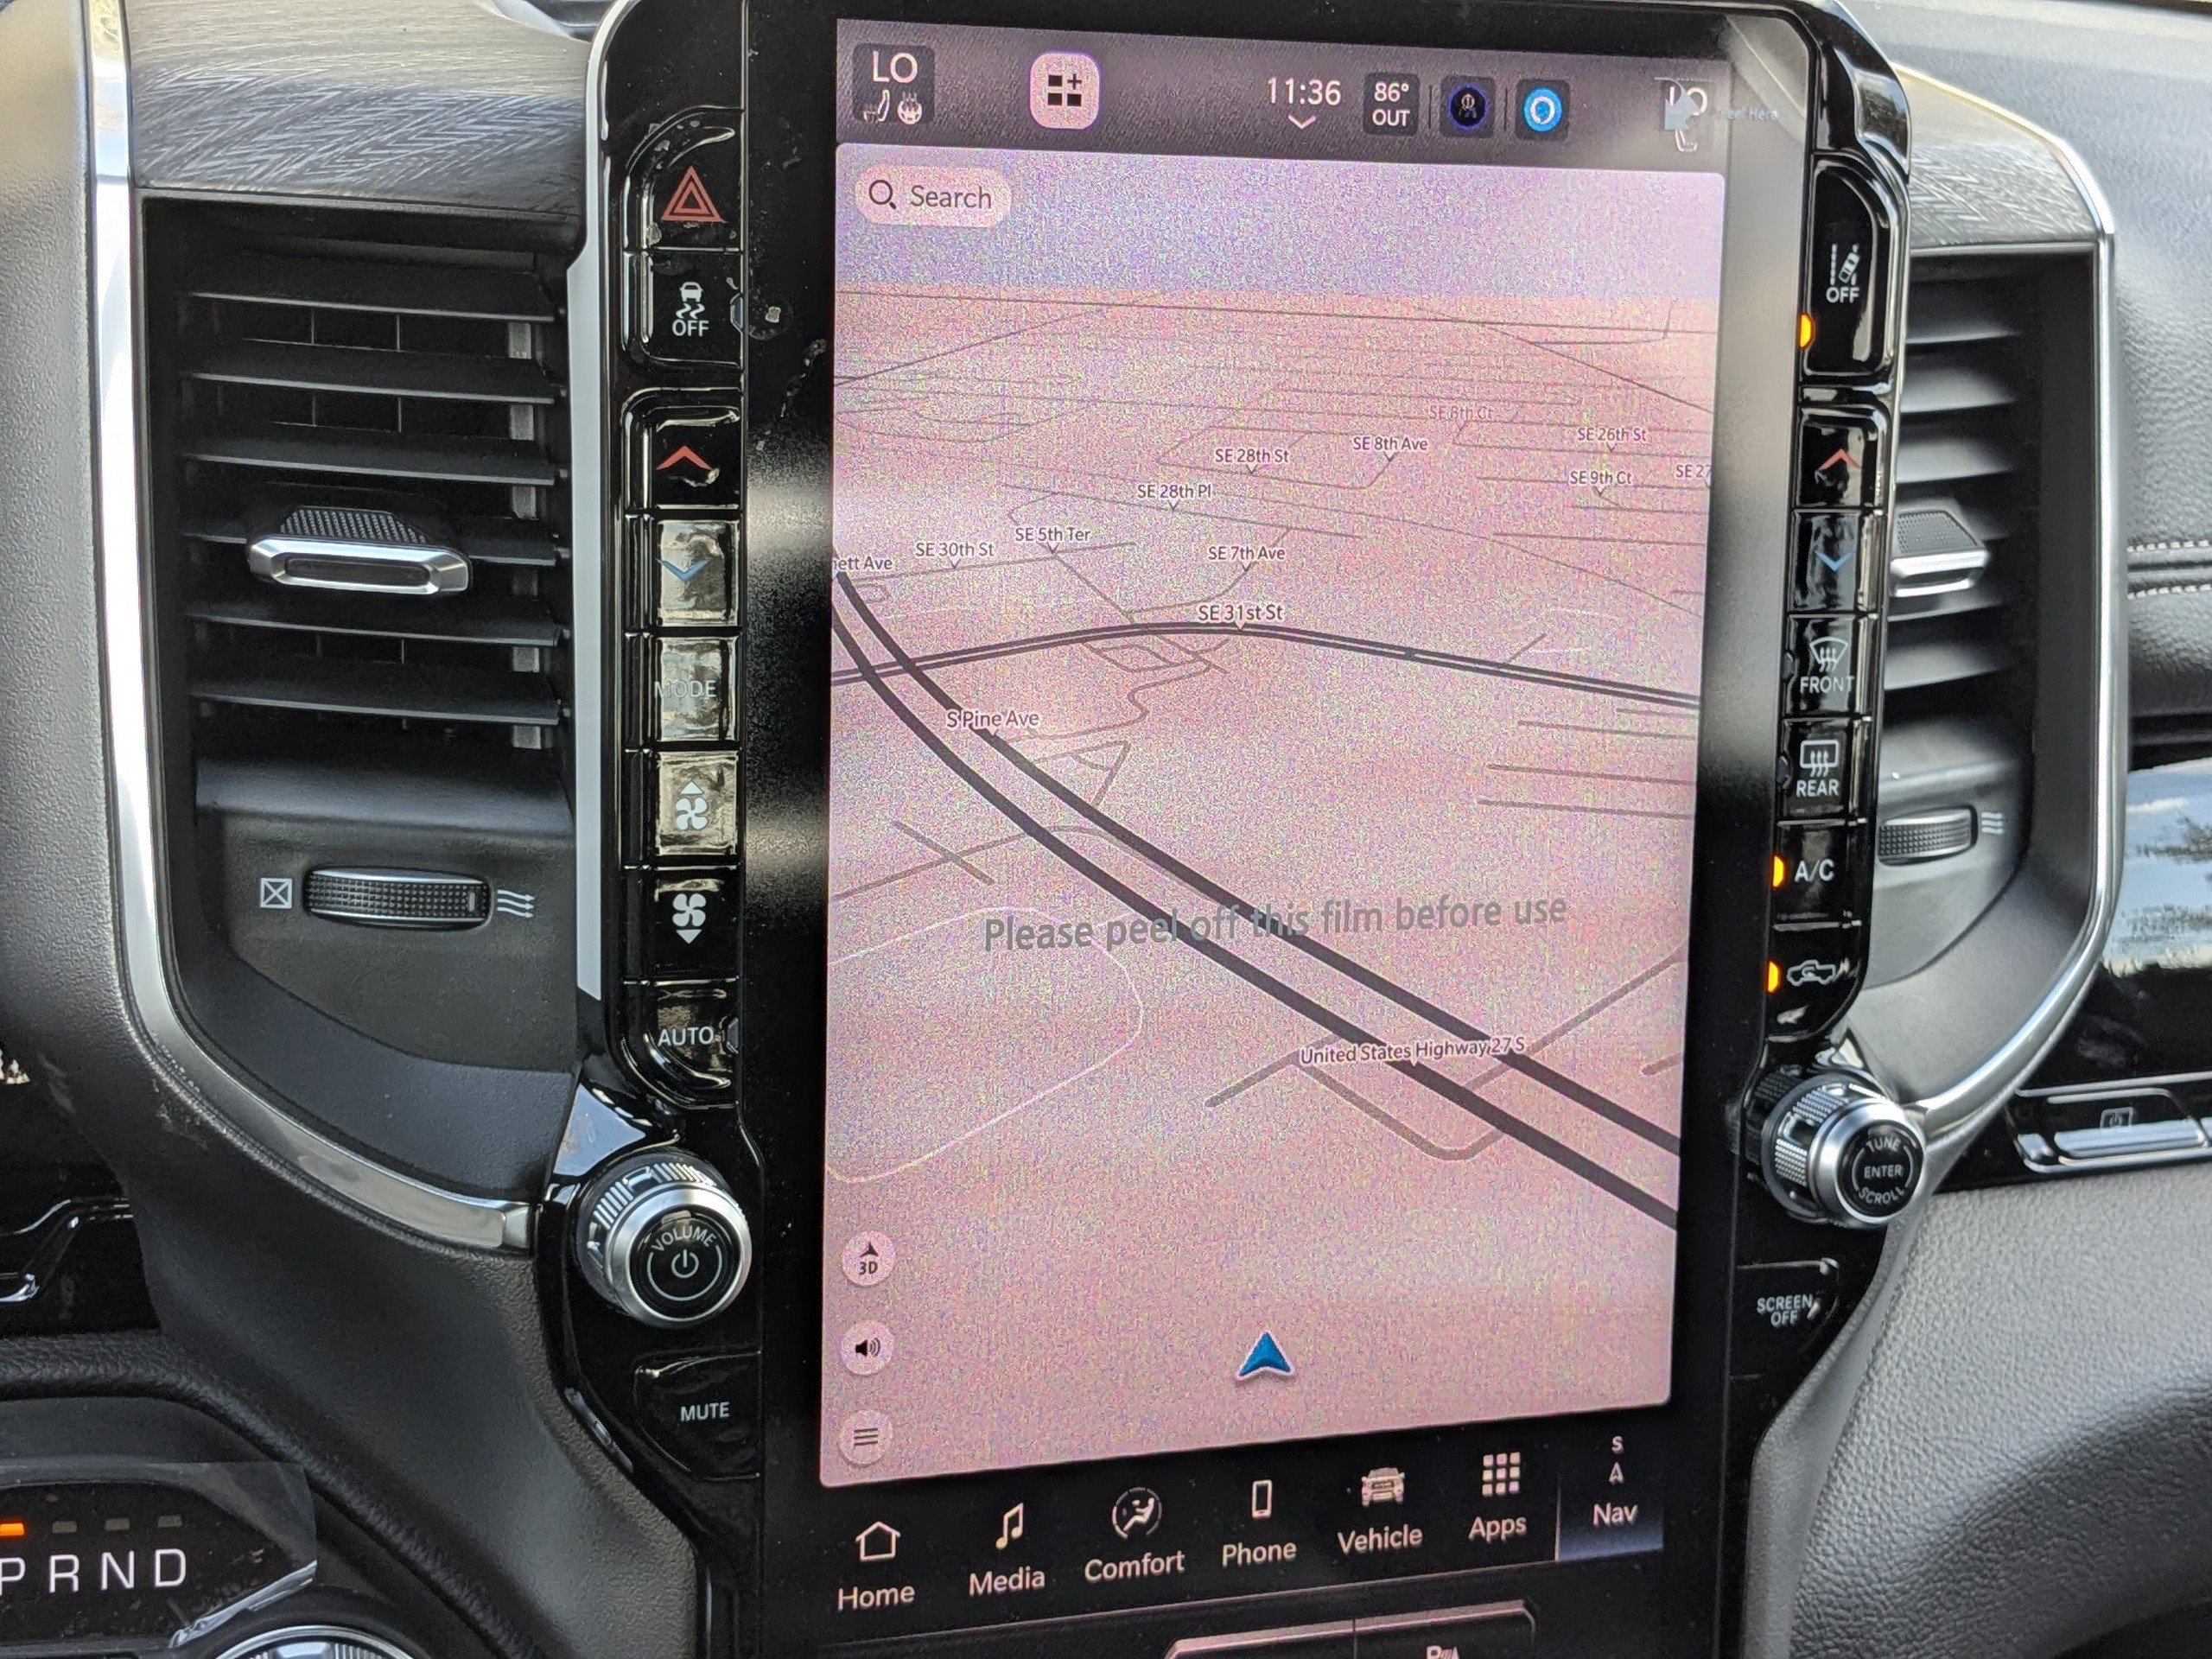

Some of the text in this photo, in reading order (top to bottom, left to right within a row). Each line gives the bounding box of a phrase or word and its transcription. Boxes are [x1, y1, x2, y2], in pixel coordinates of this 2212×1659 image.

[872, 50, 918, 84] LO
[1268, 77, 1342, 105] 11:36
[1372, 109, 1410, 127] OUT
[910, 183, 993, 210] Search
[1826, 286, 1860, 303] OFF
[672, 319, 709, 337] OFF
[1353, 437, 1428, 451] SE 8th Ave
[1577, 429, 1646, 442] SE 26th St
[1215, 449, 1289, 463] SE 28th St
[1569, 471, 1631, 485] SE 9th Ct
[1676, 464, 1692, 478] SE
[1137, 485, 1155, 499] SE
[1160, 485, 1193, 499] 28th
[1015, 526, 1090, 542] SE 5th Ter
[916, 542, 994, 557] SE 30th St
[1208, 546, 1285, 560] SE 7th Ave
[864, 556, 893, 570] Ave
[1198, 605, 1283, 620] SE 31st St
[654, 680, 717, 698] MODE
[1800, 675, 1854, 693] FRONT
[947, 709, 1039, 728] S Pine Ave
[1796, 780, 1839, 798] REAR
[1795, 860, 1834, 881] A/C
[985, 894, 1567, 950] Please peel off this film before use
[658, 1026, 715, 1046] AUTO
[1300, 1037, 1525, 1065] United States Highway 27 S
[1866, 1135, 1901, 1152] TUNE
[1864, 1164, 1902, 1179] ENTER
[1859, 1186, 1905, 1205] SCROLL
[651, 1225, 717, 1253] VOLUME
[859, 1260, 879, 1275] 3D
[1757, 1294, 1813, 1315] SCREEN
[1770, 1310, 1799, 1329] OFF
[680, 1402, 730, 1421] MUTE
[1592, 1502, 1639, 1528] Nav
[1469, 1515, 1528, 1542] Apps
[1337, 1523, 1423, 1554] Vehicle
[1221, 1540, 1298, 1567] Phone
[1084, 1549, 1186, 1583] Comfort
[969, 1565, 1046, 1596] Media
[837, 1584, 917, 1612] Home
